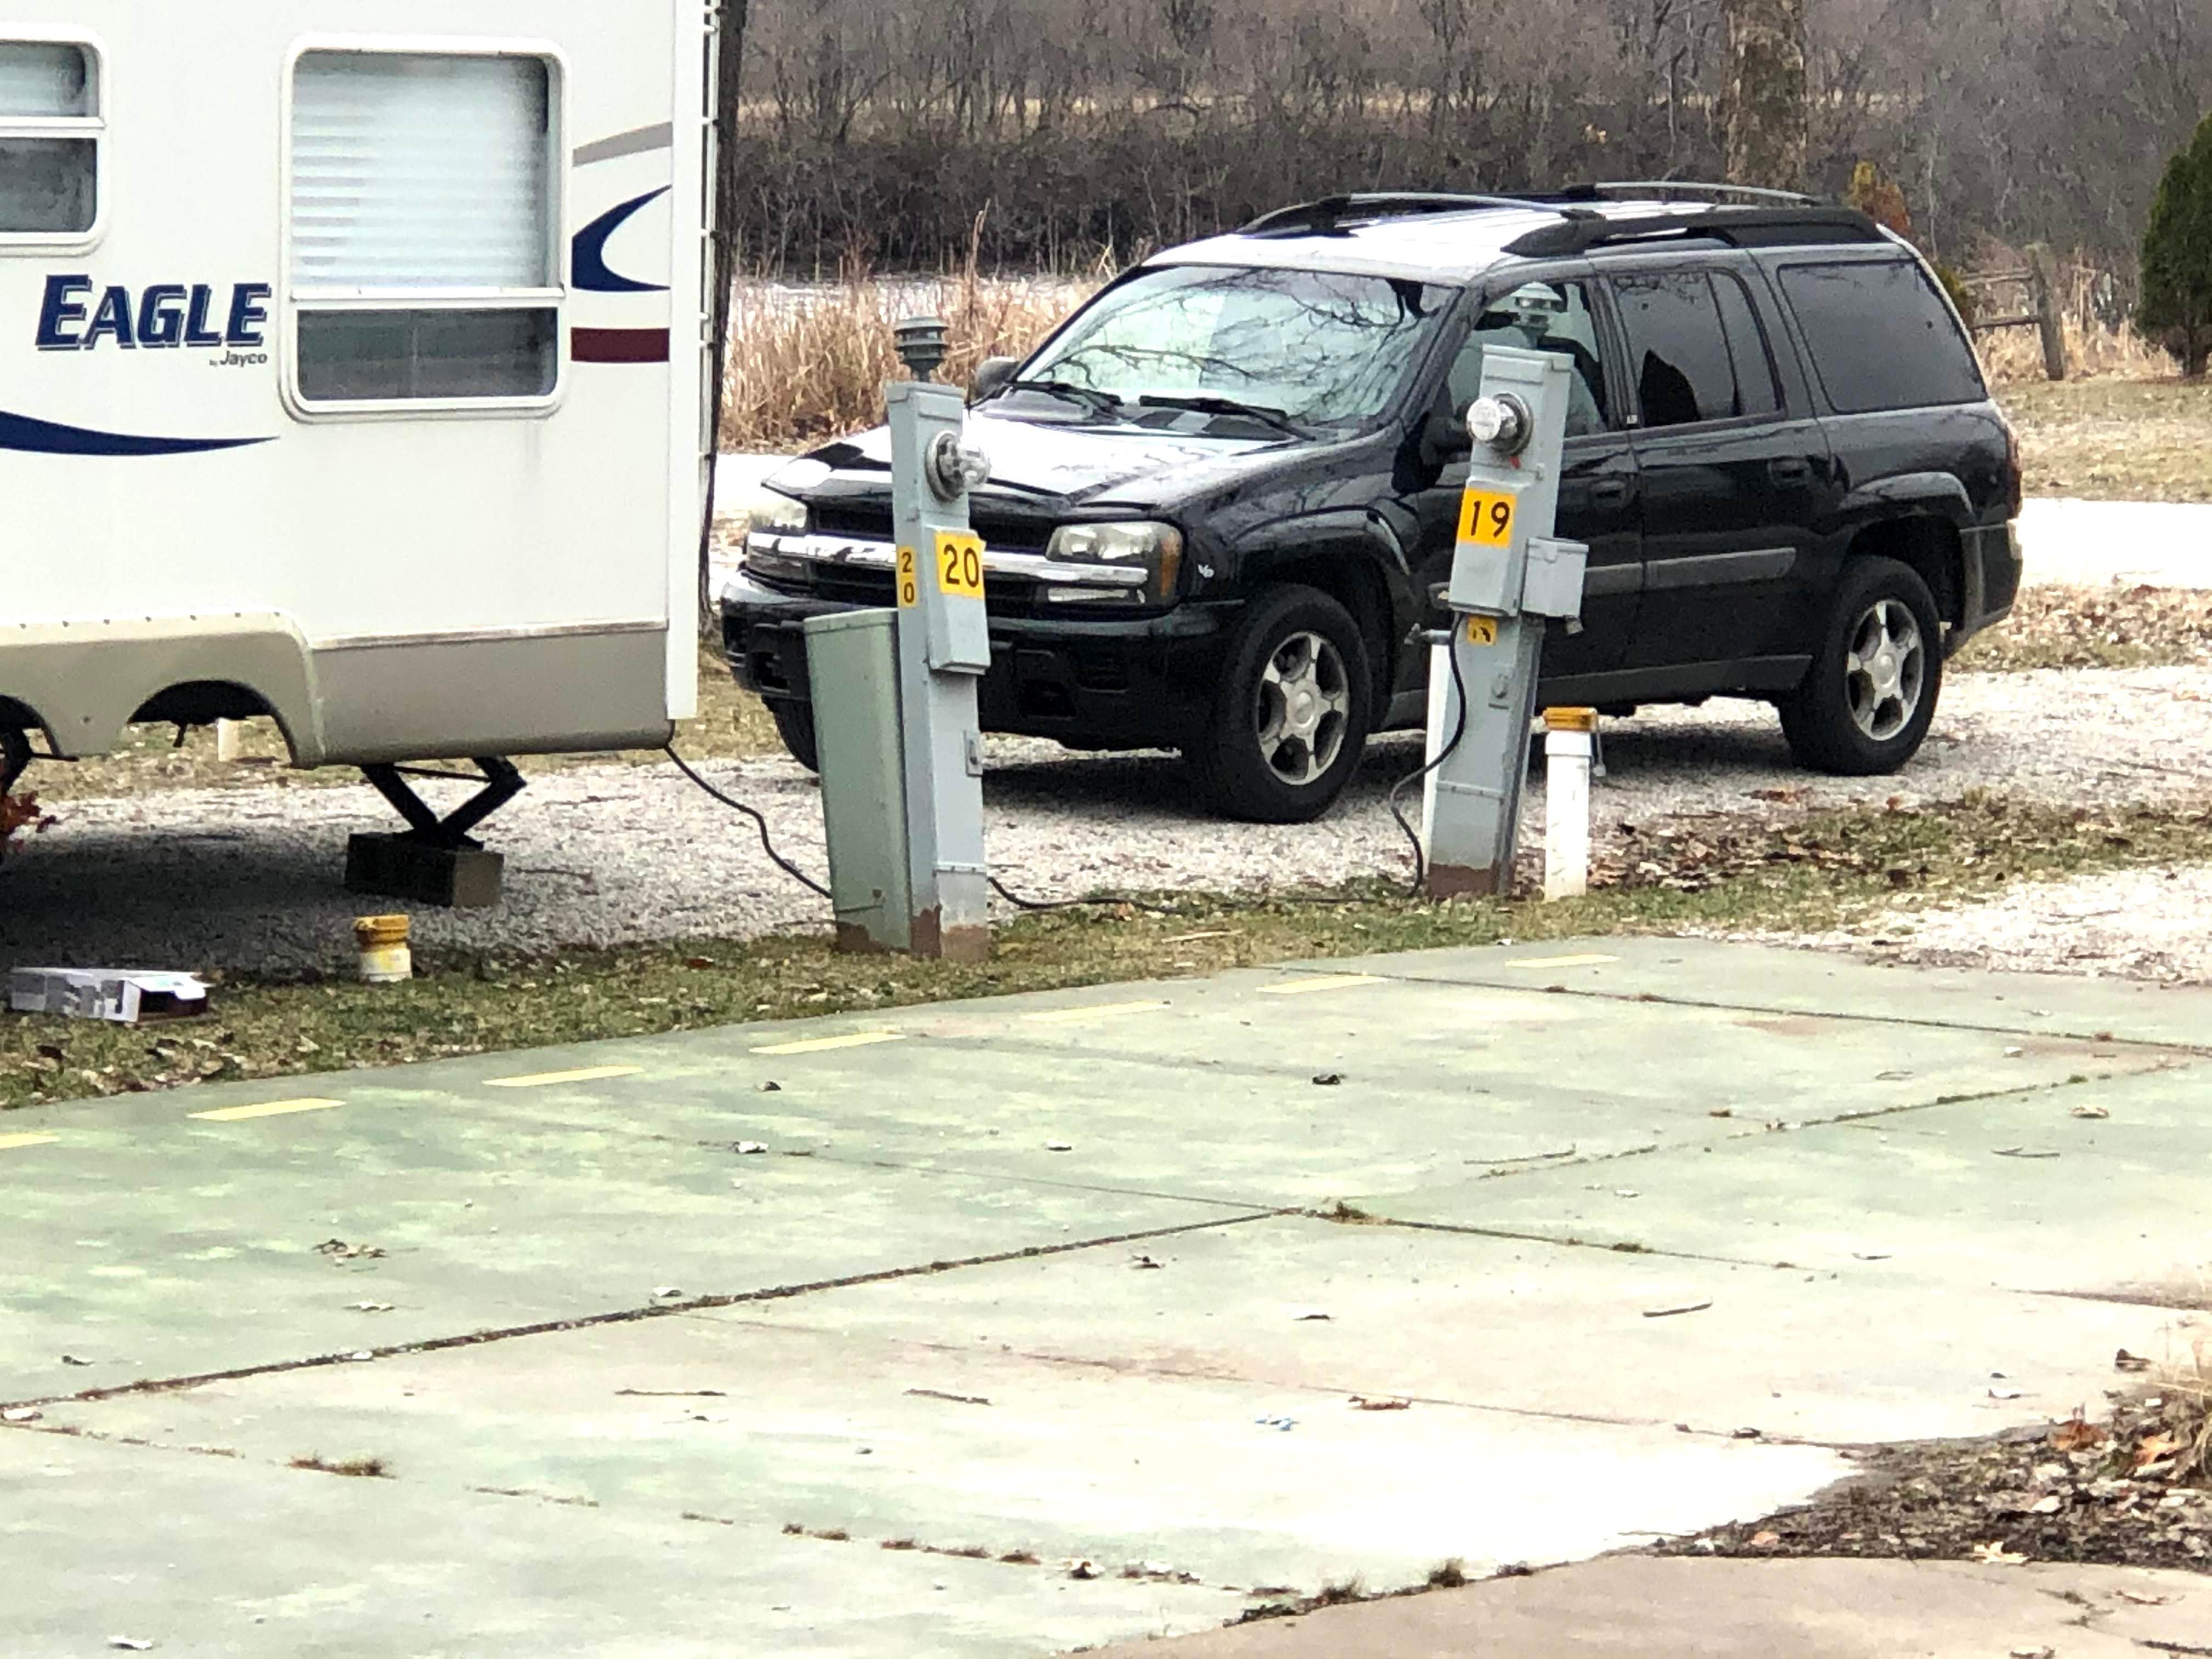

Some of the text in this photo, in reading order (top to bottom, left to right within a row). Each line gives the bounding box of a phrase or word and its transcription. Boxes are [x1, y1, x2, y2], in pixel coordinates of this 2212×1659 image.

[35, 274, 272, 351] EAGLE
[219, 350, 267, 367] Jayco
[1470, 500, 1510, 538] 19
[944, 544, 979, 588] 20
